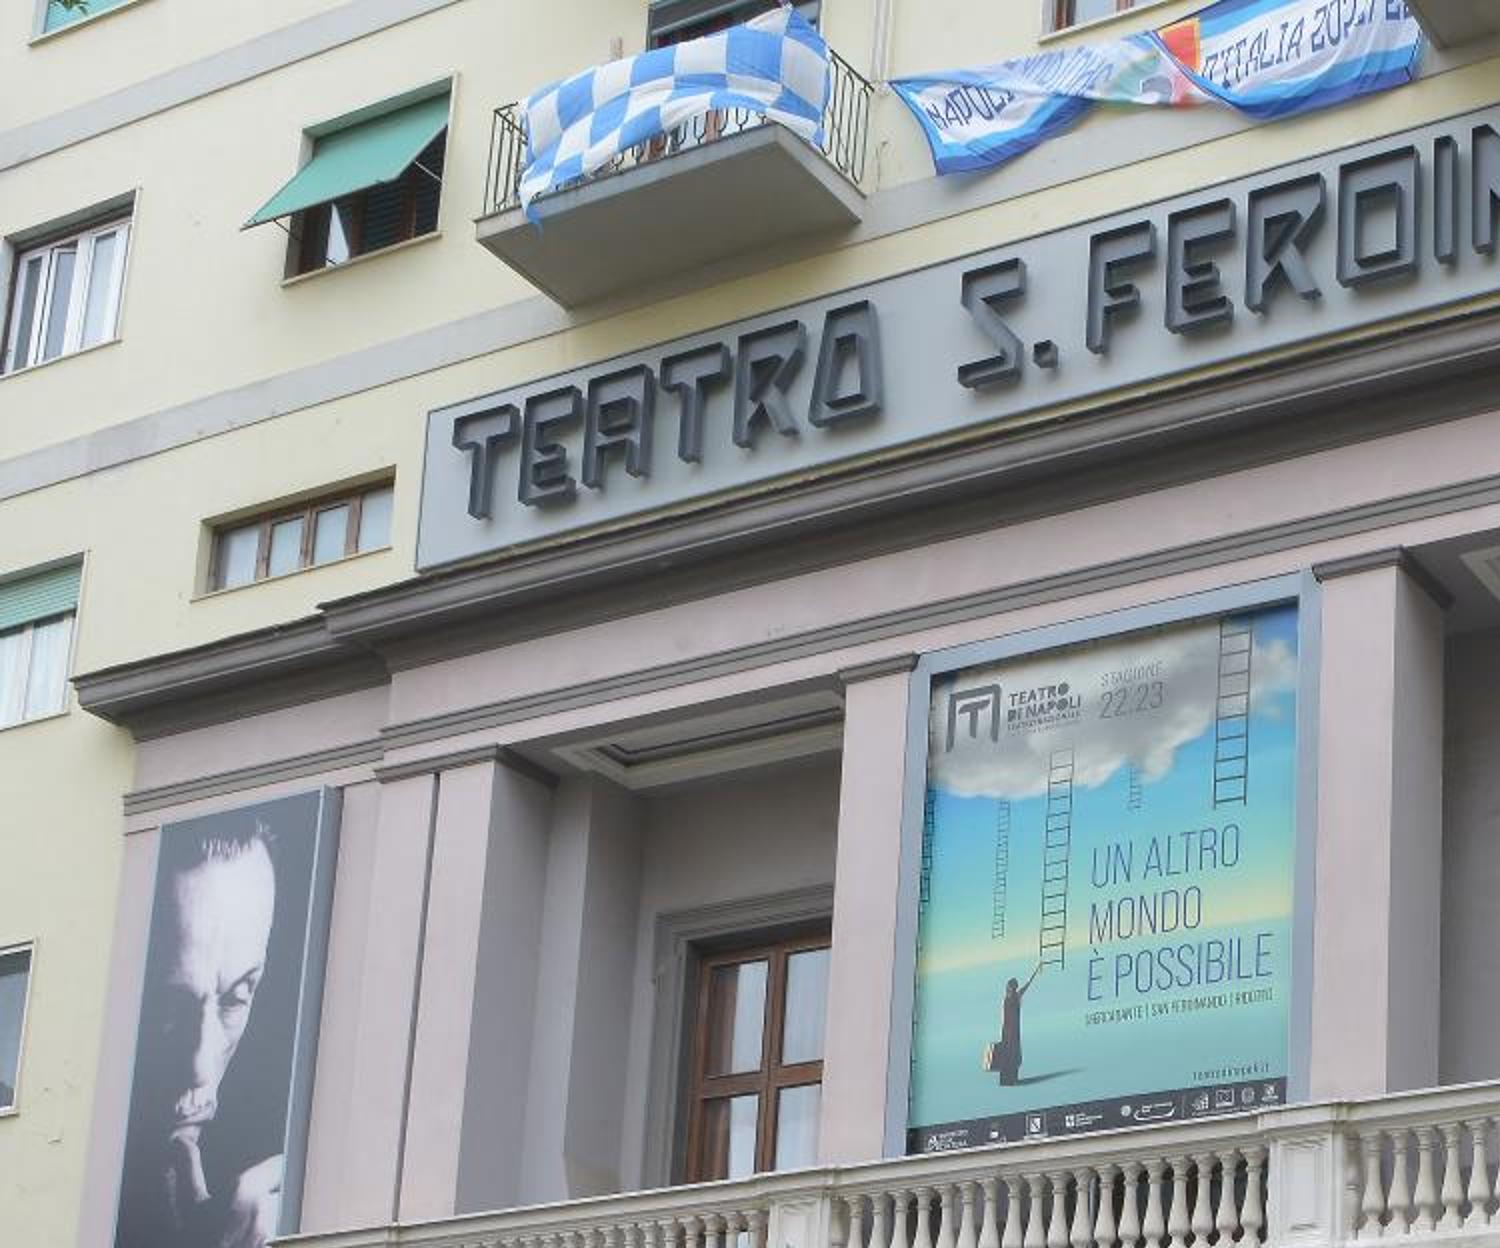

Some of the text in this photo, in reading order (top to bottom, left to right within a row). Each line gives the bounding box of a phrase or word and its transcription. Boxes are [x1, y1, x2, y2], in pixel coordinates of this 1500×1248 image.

[452, 300, 884, 521] TEATRO
[1009, 682, 1070, 707] TEATRO
[1025, 695, 1081, 719] NAPOLI
[1092, 824, 1240, 888] UN ALTRO
[1089, 886, 1201, 944] MONDO
[1087, 933, 1275, 1001] È POSSIBILE
